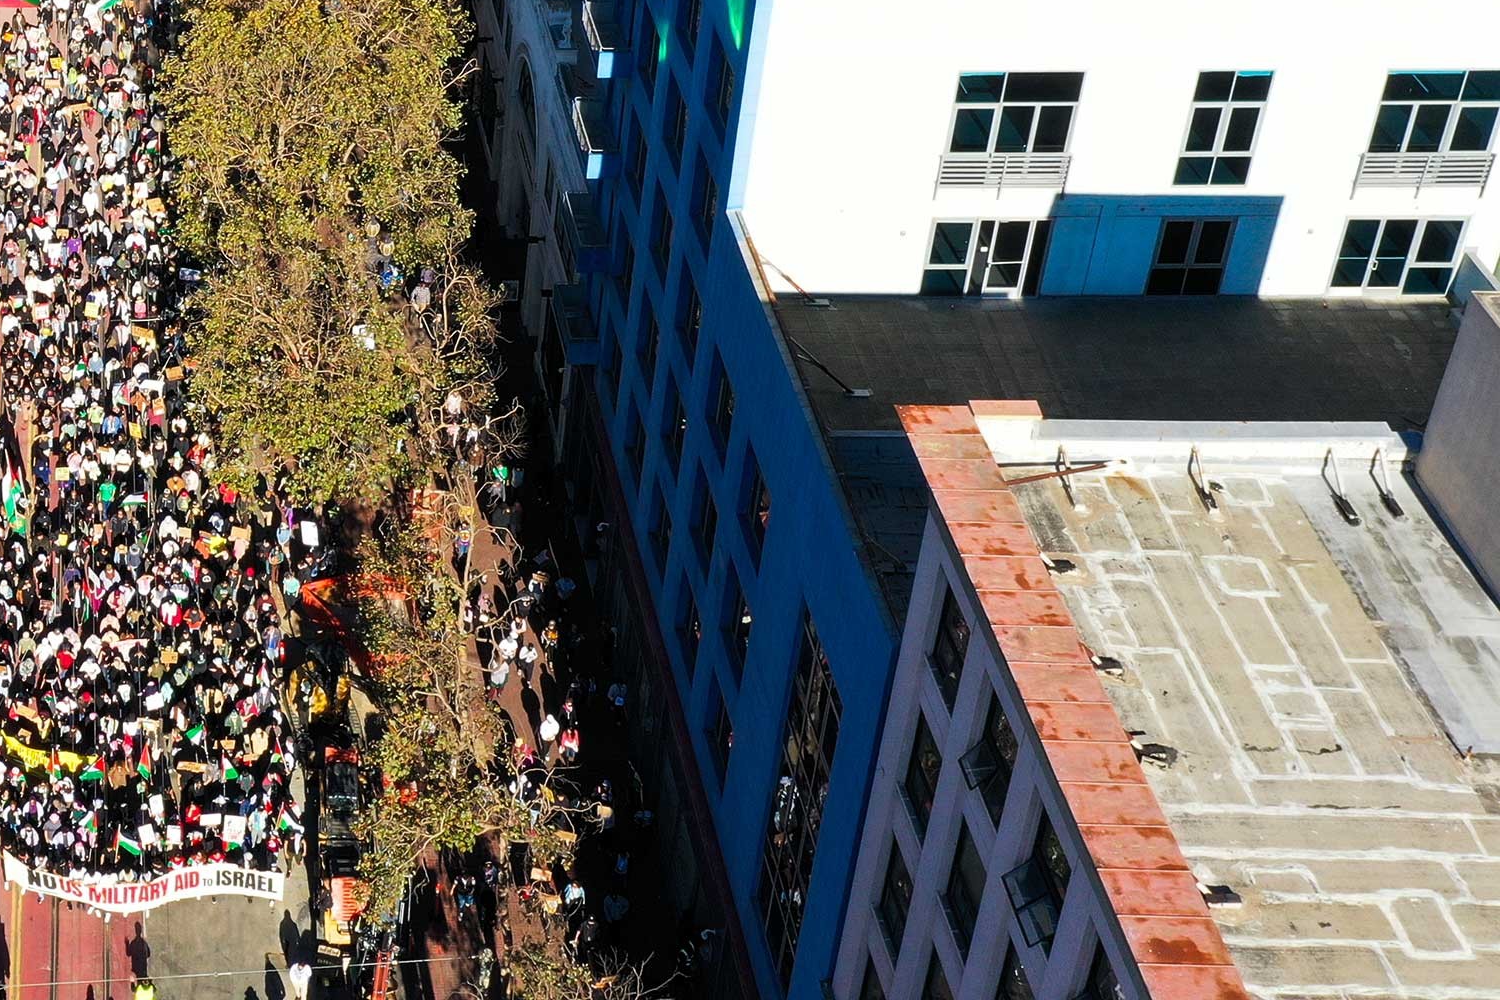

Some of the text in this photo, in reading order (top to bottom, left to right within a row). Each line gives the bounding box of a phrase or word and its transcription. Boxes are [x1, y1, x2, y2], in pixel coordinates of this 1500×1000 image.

[27, 867, 278, 905] NO US MILITARY AID TO ISRAEL
